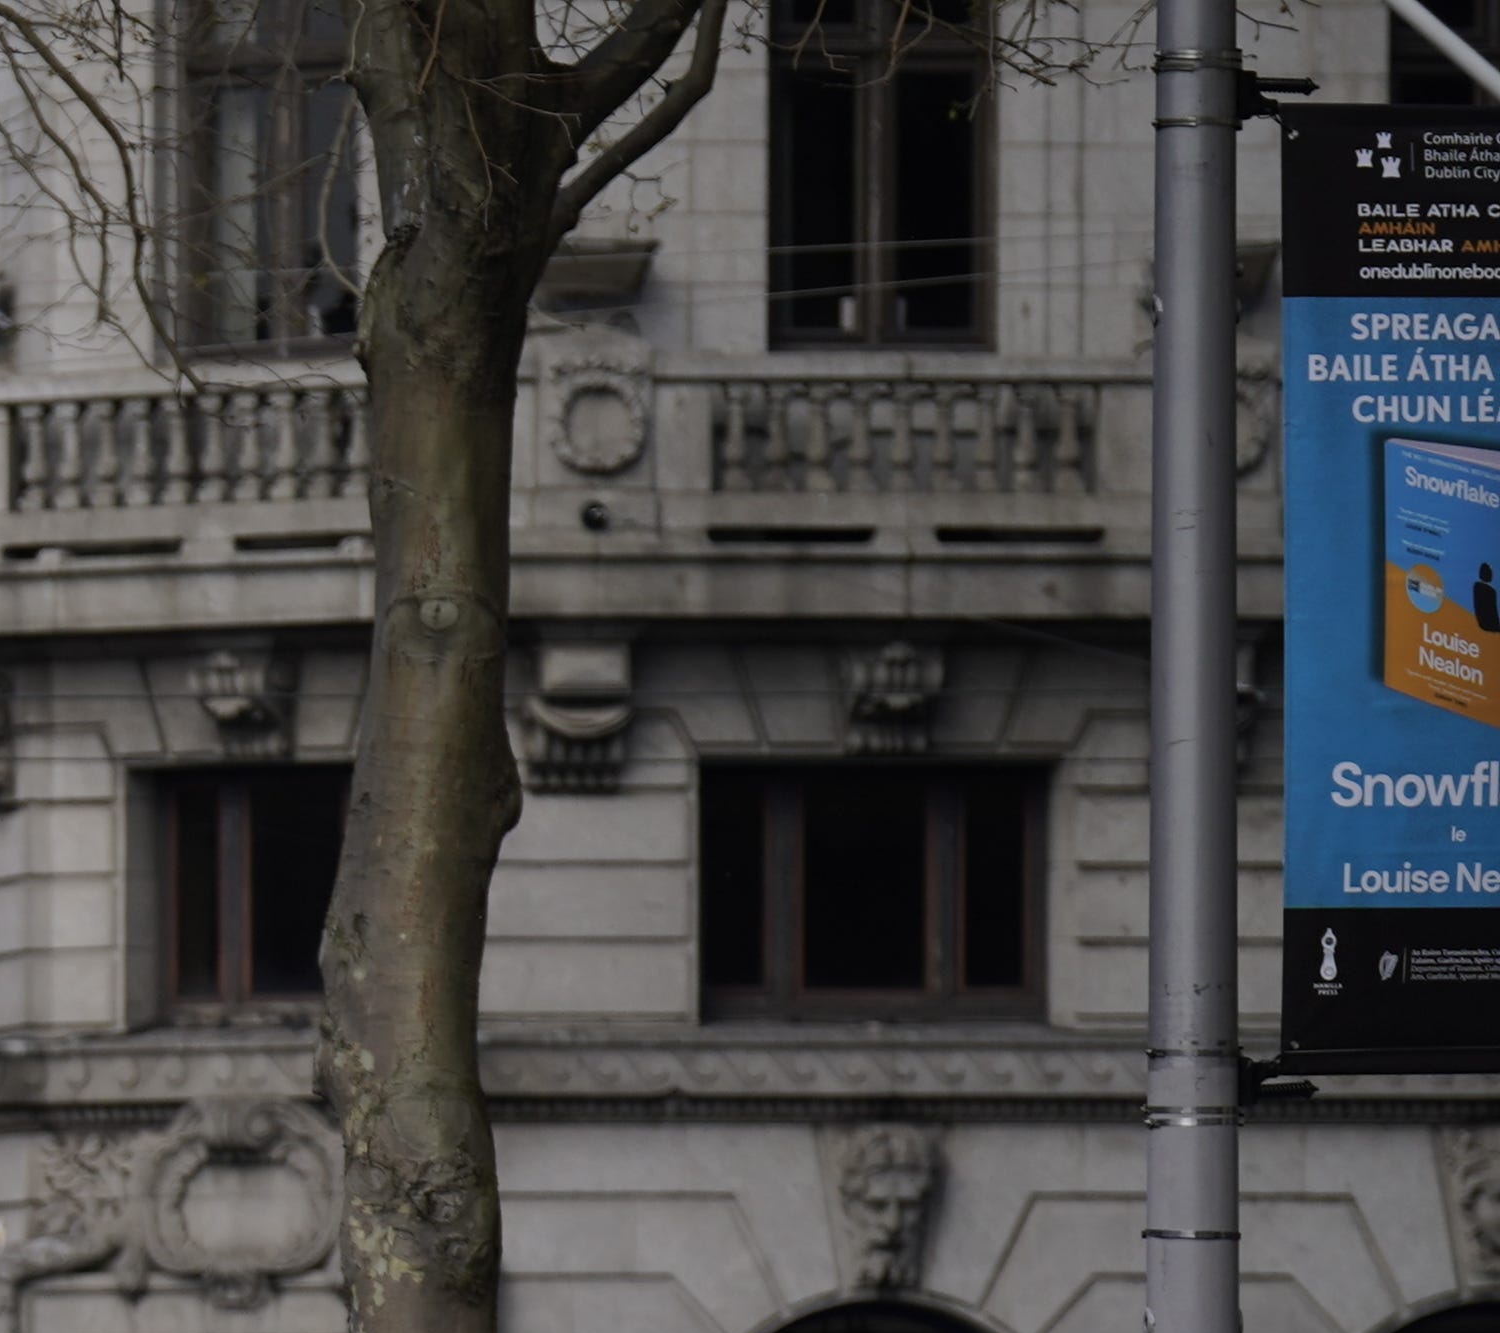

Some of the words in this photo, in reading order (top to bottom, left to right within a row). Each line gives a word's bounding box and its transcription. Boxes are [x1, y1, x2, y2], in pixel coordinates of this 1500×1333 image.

[1422, 131, 1493, 145] Comhairle
[1423, 148, 1467, 162] Bhaile
[1470, 147, 1500, 162] Átha
[1424, 165, 1470, 179] Dublin
[1473, 165, 1500, 182] City
[1357, 203, 1420, 218] BAILE
[1426, 203, 1480, 218] ATHA
[1358, 219, 1436, 235] AMHÁIN
[1358, 238, 1454, 253] LEABHAR
[1350, 312, 1500, 341] SPREAGA
[1308, 354, 1399, 382] BAILE
[1407, 347, 1496, 382] ÁTHA
[1351, 395, 1451, 423] CHUN
[1461, 388, 1500, 423] LÉ
[1404, 465, 1499, 509] Snowflake
[1422, 622, 1480, 658] Louise
[1418, 646, 1484, 686] Nealon
[1451, 825, 1467, 842] le
[1343, 861, 1450, 893] Louise
[1456, 862, 1500, 893] Ne
